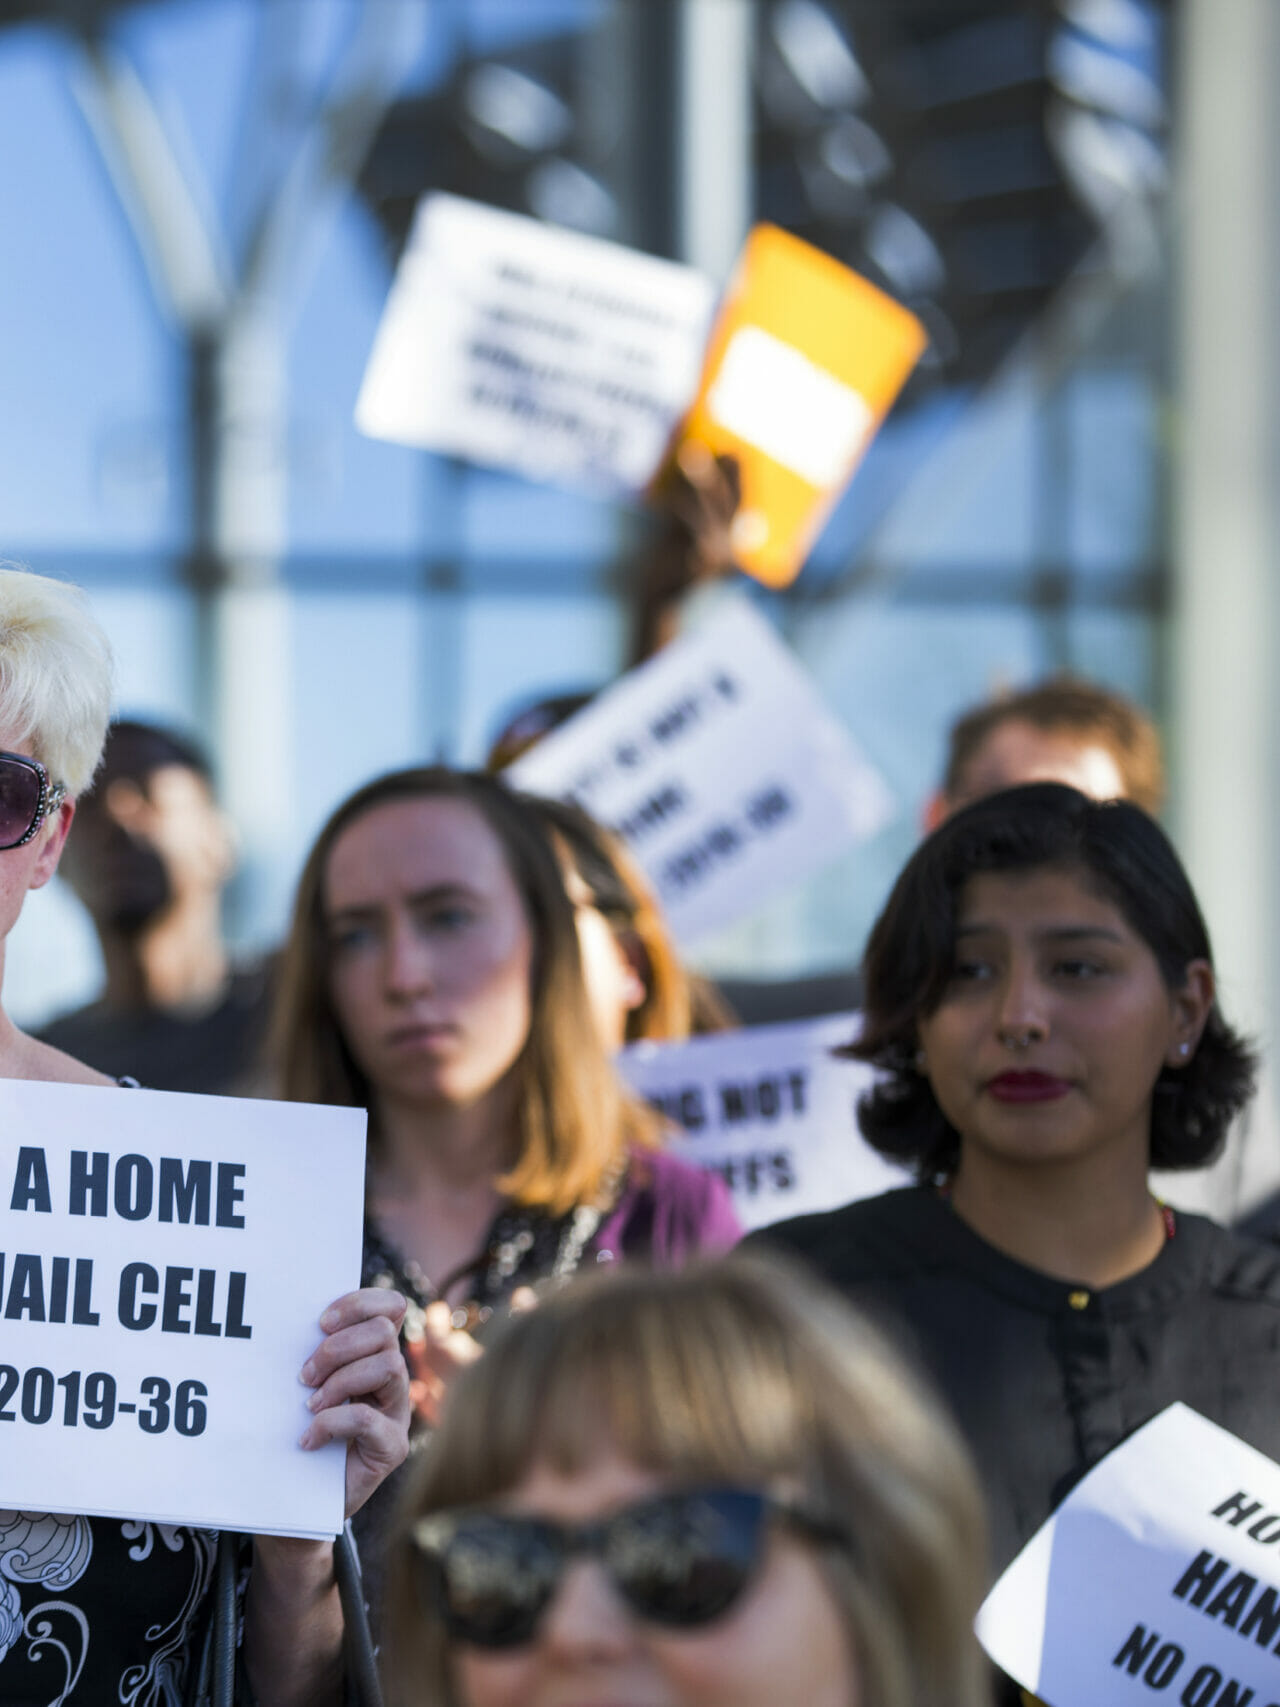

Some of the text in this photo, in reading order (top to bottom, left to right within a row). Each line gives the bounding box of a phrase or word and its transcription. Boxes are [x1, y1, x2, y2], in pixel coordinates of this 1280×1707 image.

[719, 1068, 807, 1124] NOT
[10, 1147, 52, 1213] A
[69, 1150, 246, 1229] HOME
[117, 1262, 252, 1340] CELL
[1172, 1549, 1280, 1659] HAN
[1112, 1622, 1185, 1690] NO
